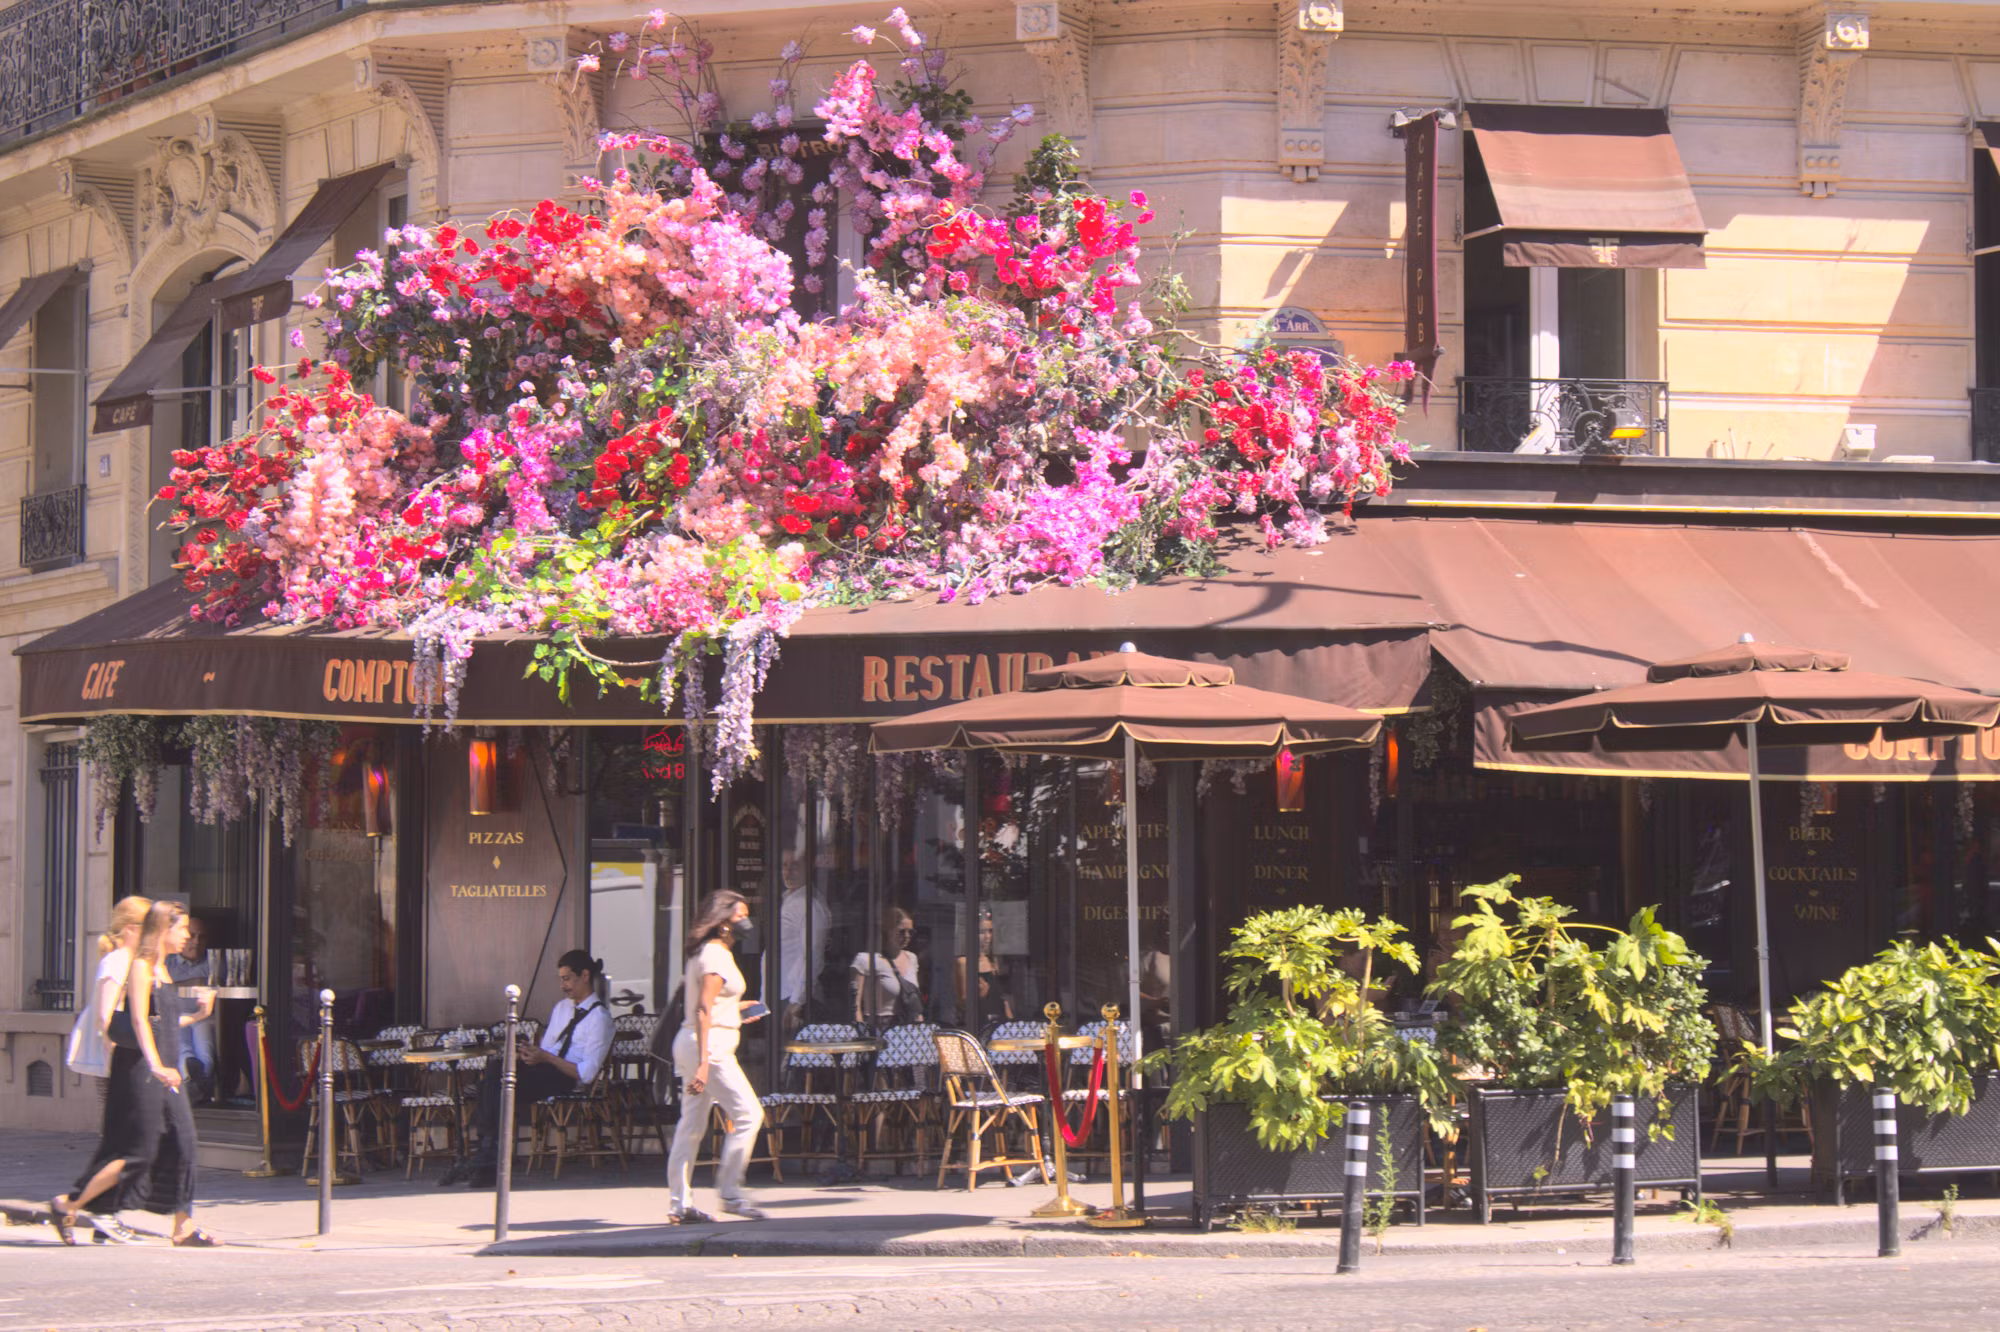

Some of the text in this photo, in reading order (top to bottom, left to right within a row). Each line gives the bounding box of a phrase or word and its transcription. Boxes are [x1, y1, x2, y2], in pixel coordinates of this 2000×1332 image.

[468, 831, 524, 845] PIZZAS
[1254, 825, 1309, 840] LUNCH
[1254, 865, 1309, 881] DINER
[1768, 866, 1857, 881] COCKTAILS
[450, 885, 546, 897] TAGLIATELLES
